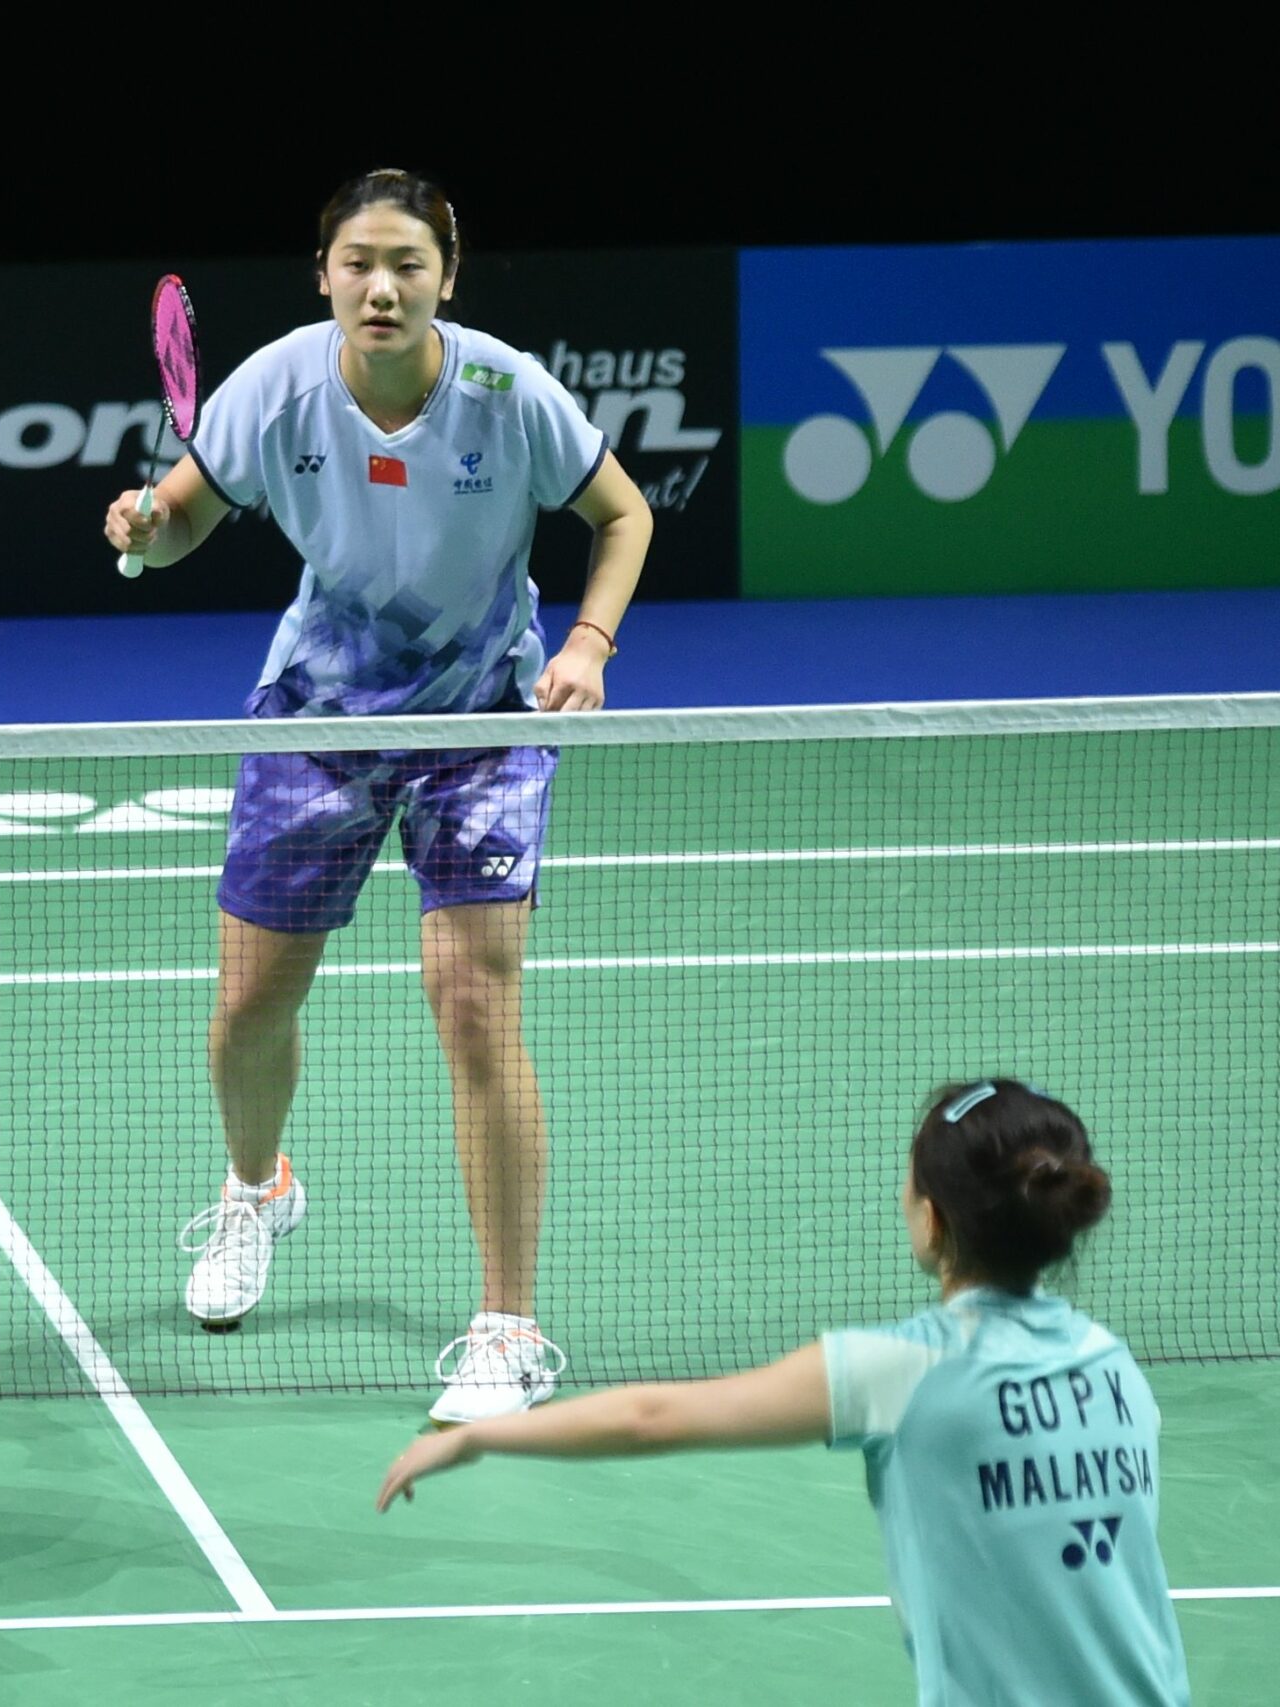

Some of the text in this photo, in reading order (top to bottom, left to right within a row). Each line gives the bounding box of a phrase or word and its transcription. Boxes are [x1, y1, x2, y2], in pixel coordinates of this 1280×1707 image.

[534, 339, 687, 387] haus
[996, 1376, 1061, 1438] GO
[977, 1446, 1154, 1513] MALAYSIA
